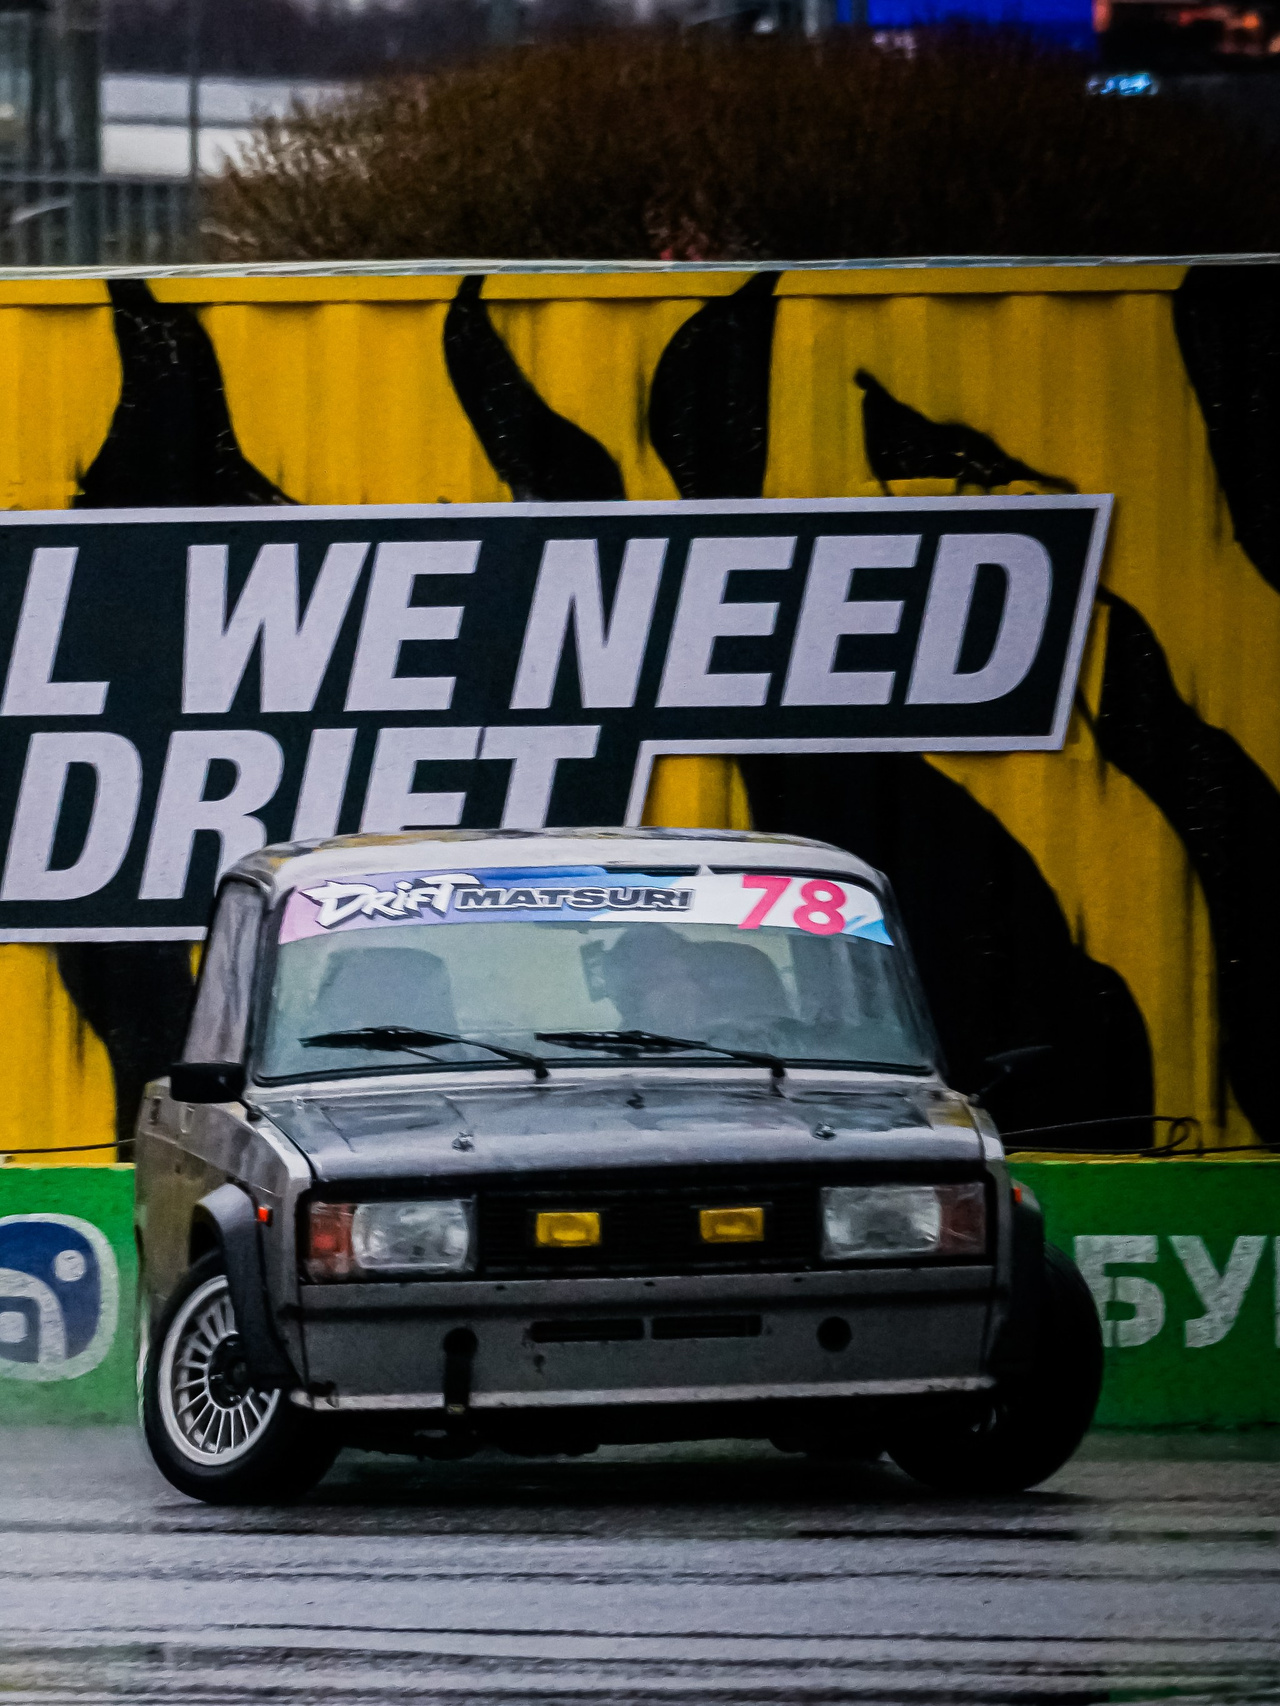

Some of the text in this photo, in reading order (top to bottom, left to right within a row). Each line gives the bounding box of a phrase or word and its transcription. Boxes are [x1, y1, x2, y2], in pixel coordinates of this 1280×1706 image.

[181, 540, 482, 714] WE
[510, 533, 1053, 709] NEED
[454, 886, 696, 911] MATSURI
[738, 875, 846, 935] 78
[1074, 1235, 1280, 1348] БУ
